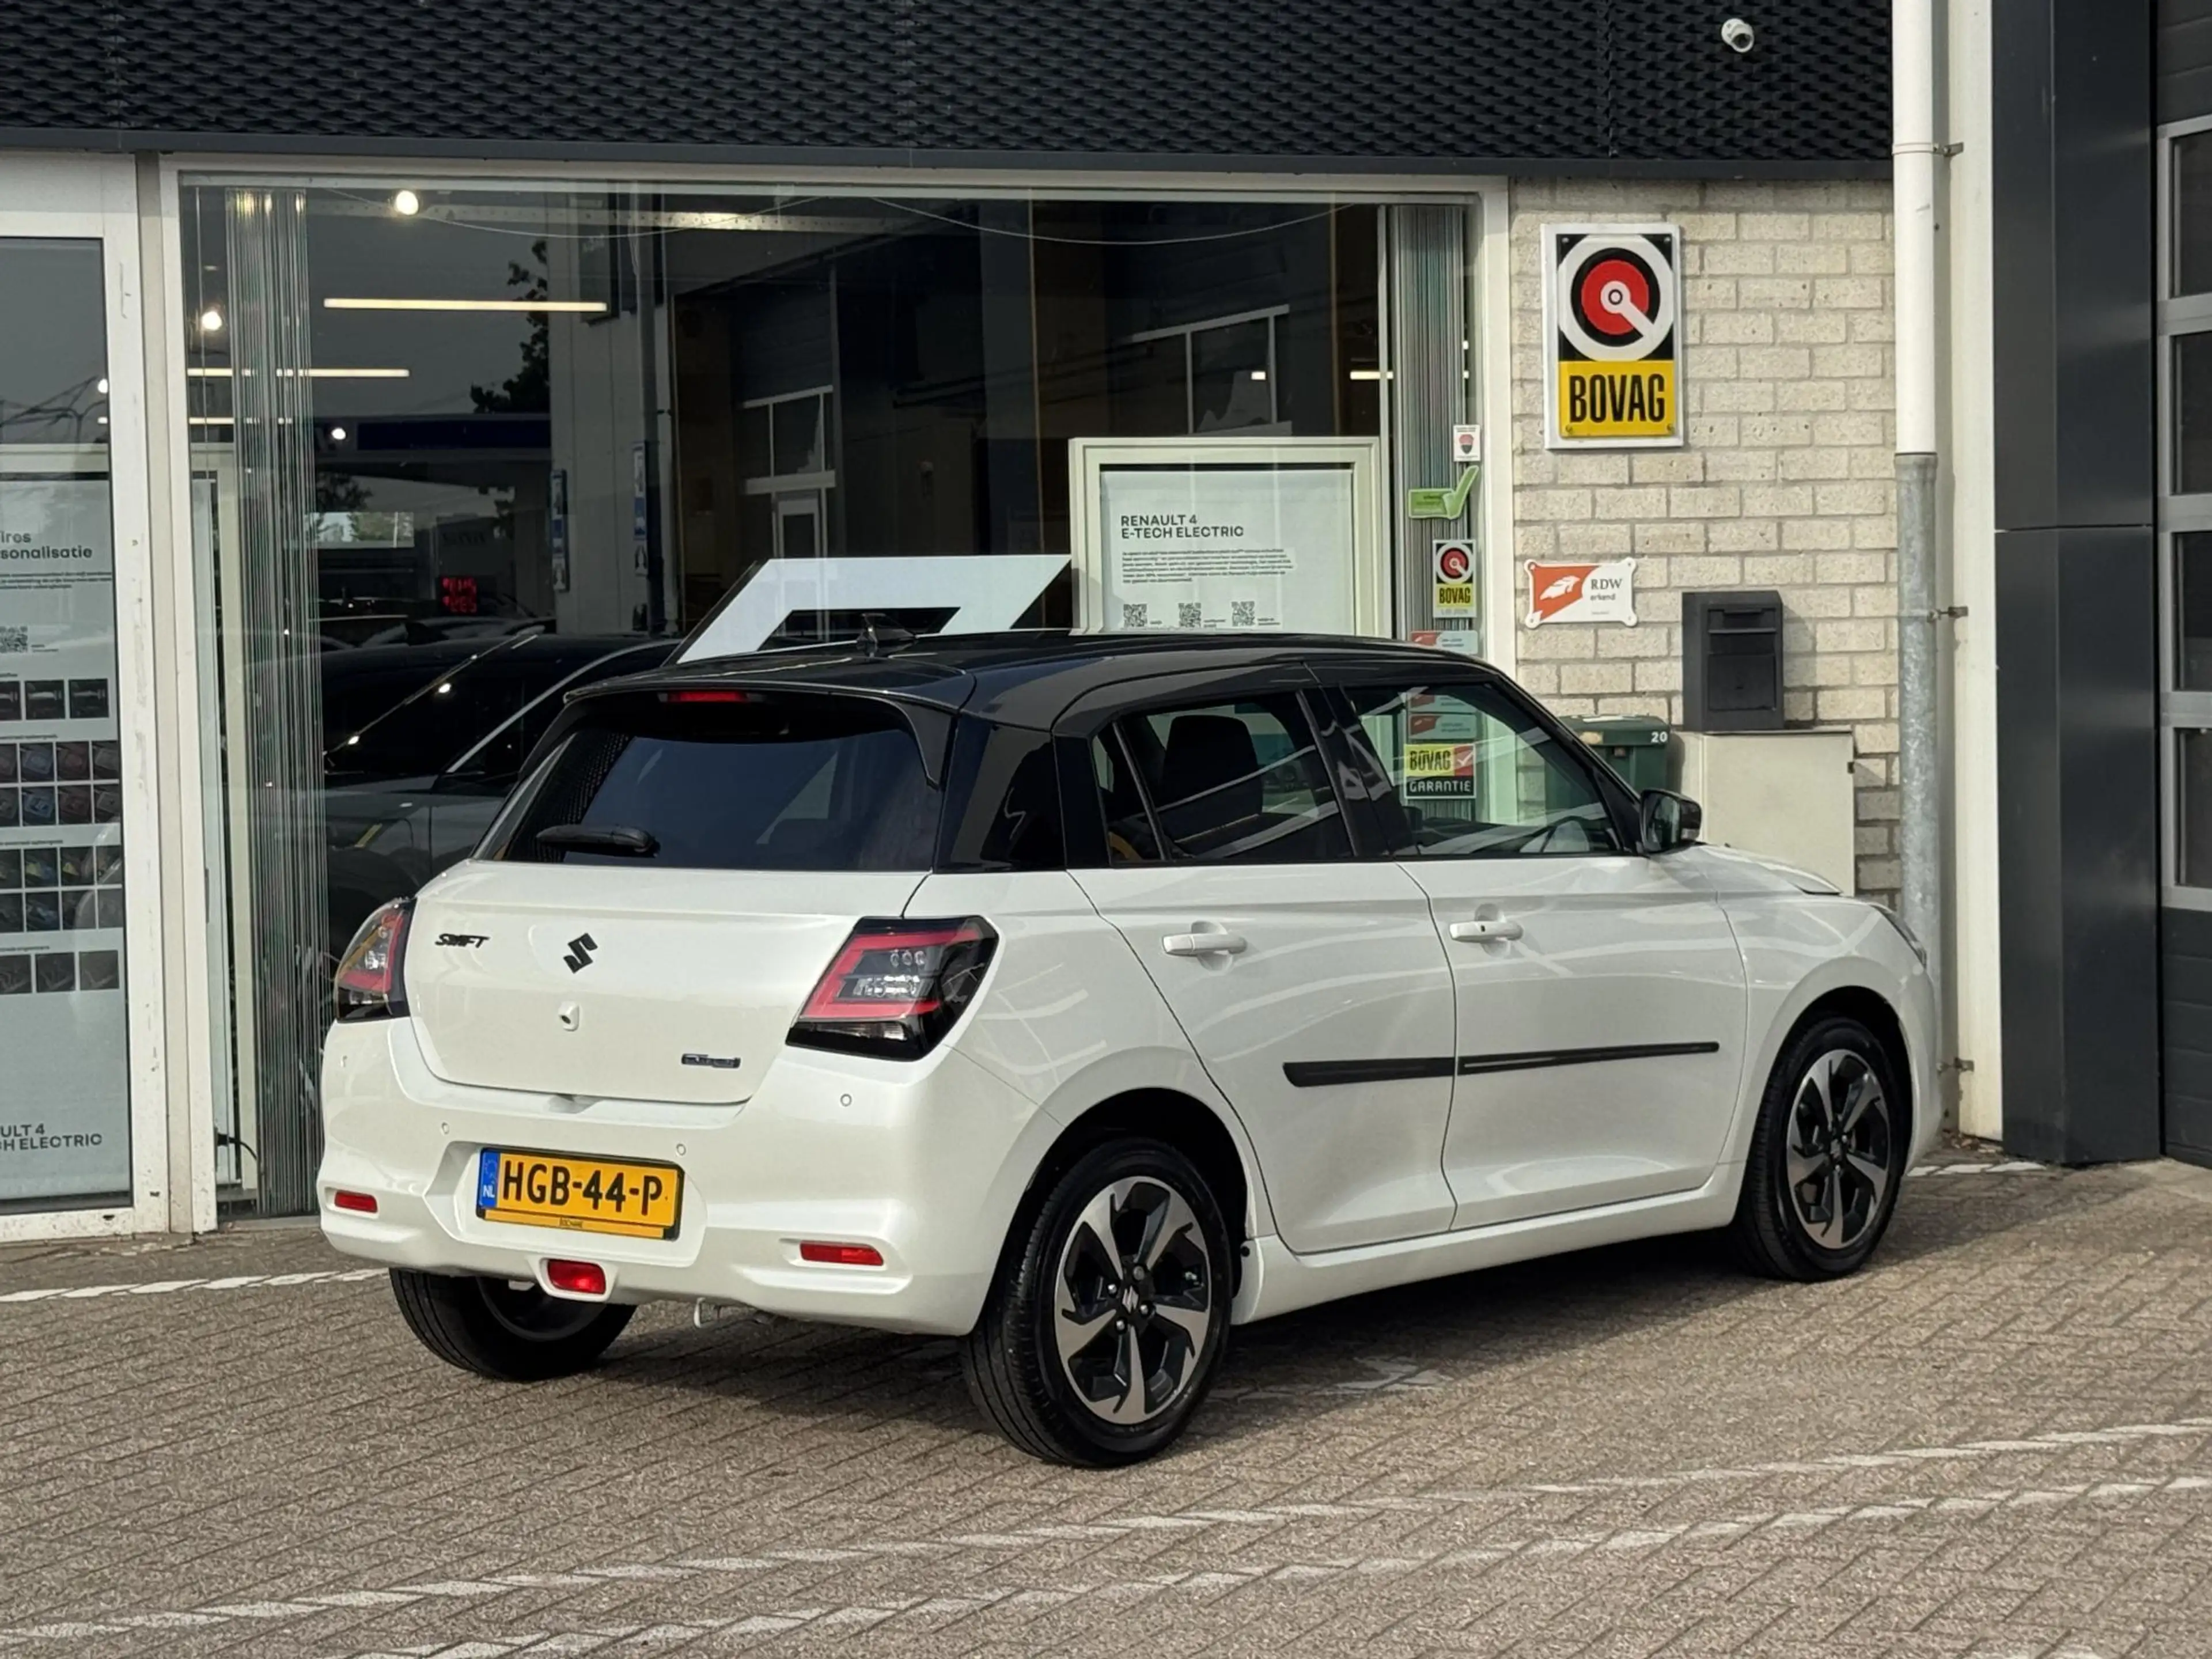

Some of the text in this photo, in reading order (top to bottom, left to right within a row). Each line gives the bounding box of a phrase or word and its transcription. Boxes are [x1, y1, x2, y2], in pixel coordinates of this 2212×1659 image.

[1570, 374, 1665, 423] BOVAG
[1120, 514, 1197, 527] RENAULT 4
[1121, 525, 1244, 539] E-TECH ELECTRIC
[1590, 578, 1622, 590] RDW
[1439, 587, 1471, 604] BOVAG
[1651, 732, 1668, 743] 20
[1410, 751, 1451, 771] BOVAG
[1410, 781, 1471, 792] GARANTIE
[435, 933, 490, 948] SWIFT
[35, 1123, 45, 1135] 4
[20, 1133, 102, 1150] ELECTRIC
[483, 1186, 495, 1198] NL
[503, 1160, 662, 1215] HGB-44-P
